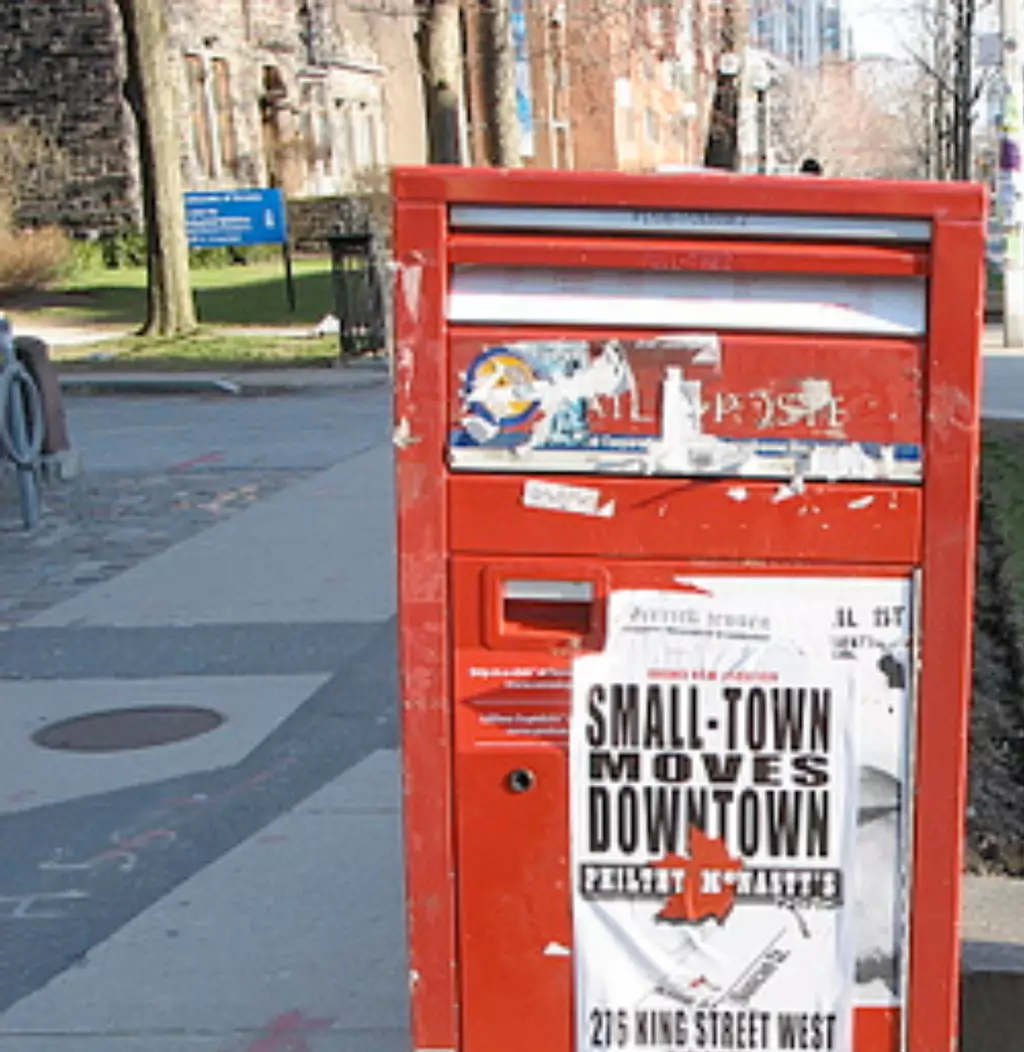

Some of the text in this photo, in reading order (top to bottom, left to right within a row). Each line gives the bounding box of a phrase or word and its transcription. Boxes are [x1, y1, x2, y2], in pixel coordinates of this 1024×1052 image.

[585, 684, 832, 754] SMALL-TOWN
[588, 751, 830, 787] MOVES
[588, 785, 830, 858] DOWNTOWN
[634, 1009, 689, 1048] KING
[695, 1009, 771, 1050] STREET
[778, 1011, 837, 1051] WEST
